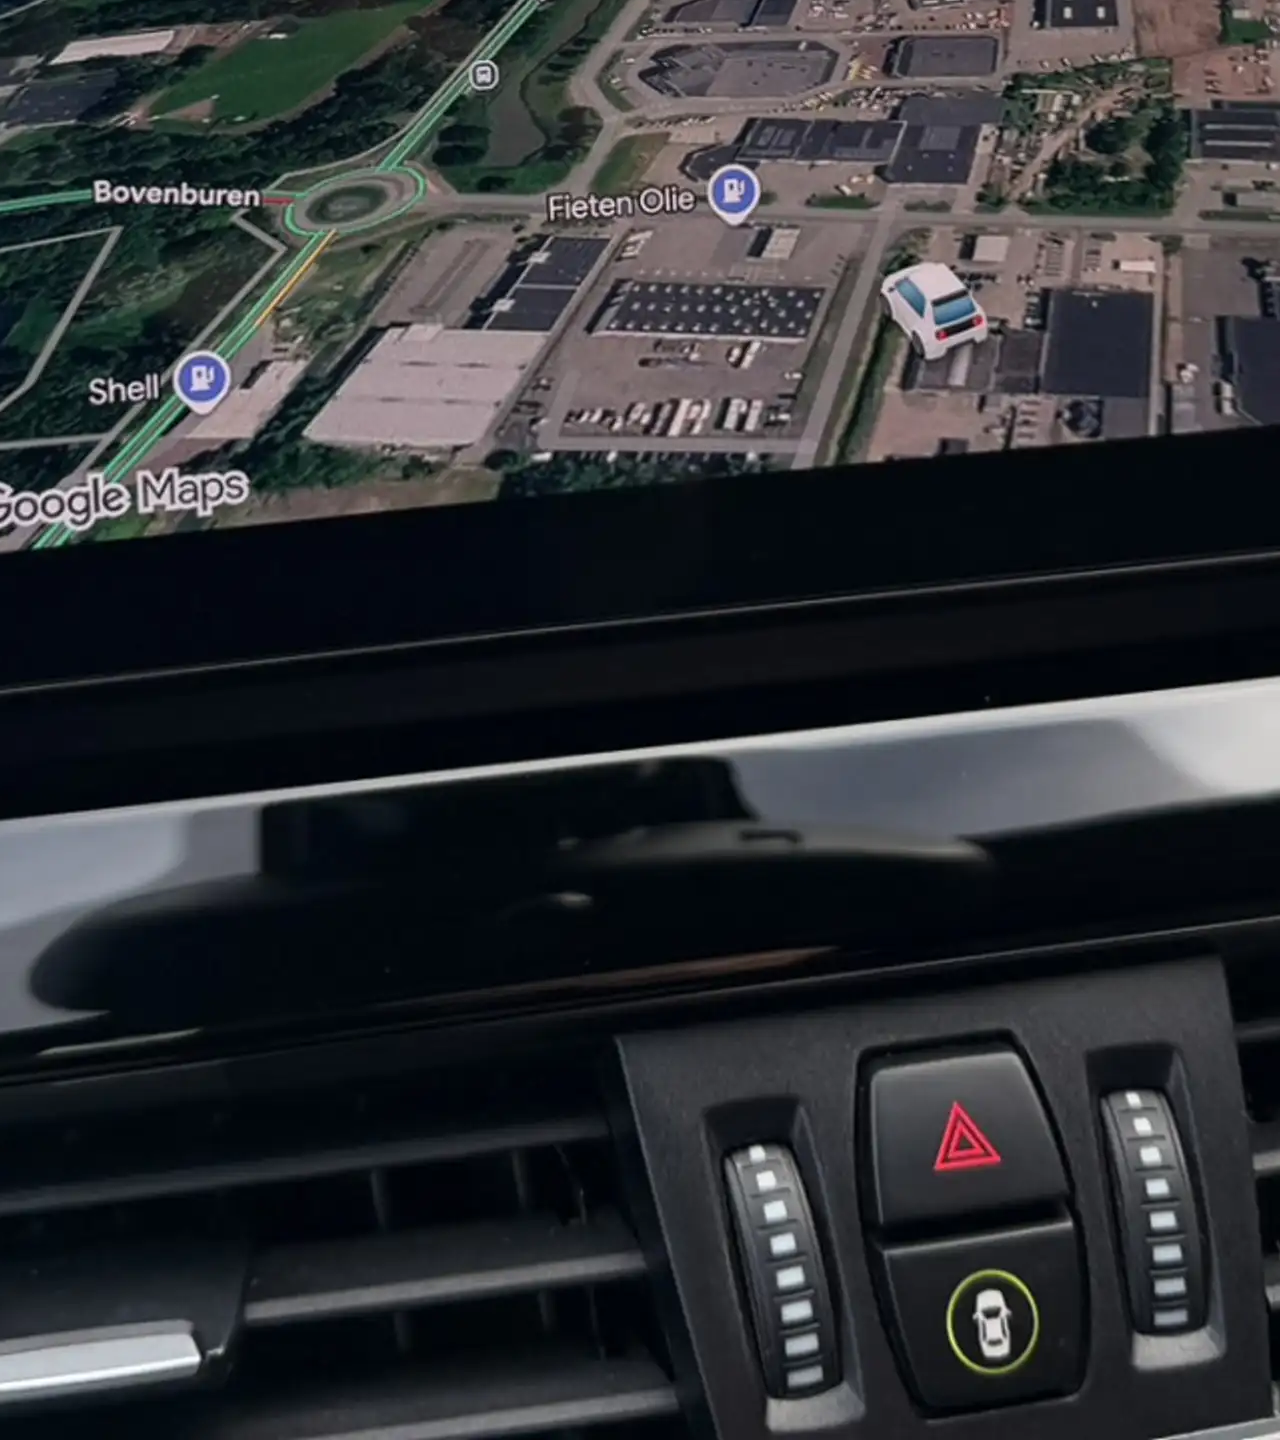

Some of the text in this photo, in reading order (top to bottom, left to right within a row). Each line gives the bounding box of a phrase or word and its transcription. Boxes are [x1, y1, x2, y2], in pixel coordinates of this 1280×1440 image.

[93, 179, 260, 208] Bovenburen
[547, 187, 695, 222] Fieten Olie
[88, 374, 160, 406] Shell
[140, 468, 248, 512] Maps
